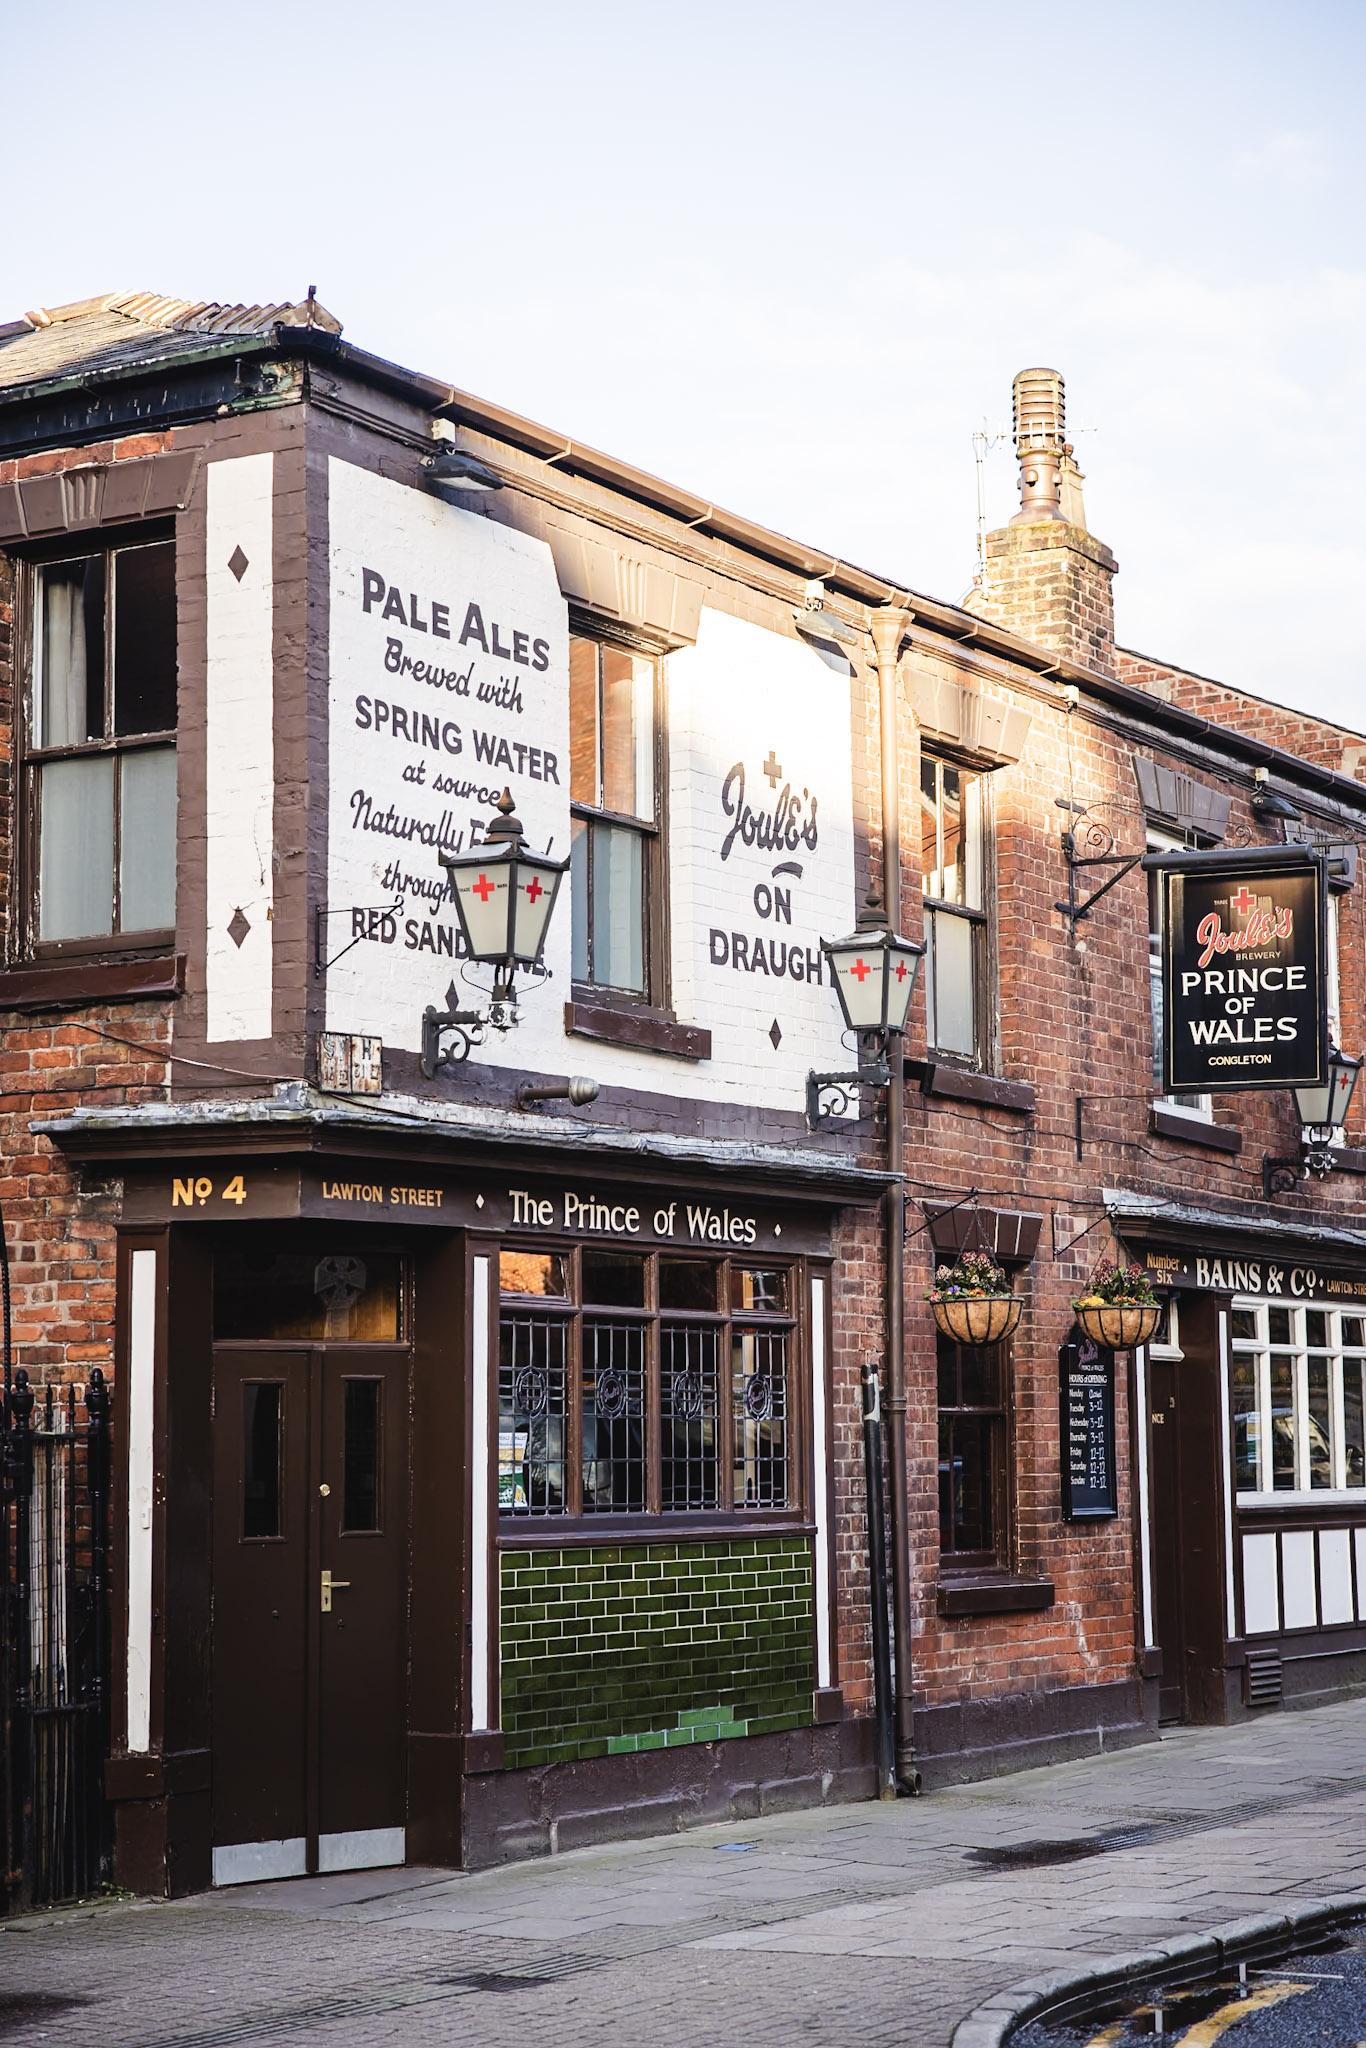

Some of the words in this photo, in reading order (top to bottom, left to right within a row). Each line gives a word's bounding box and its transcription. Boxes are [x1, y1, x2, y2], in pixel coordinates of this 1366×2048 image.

[362, 566, 450, 640] PALE
[458, 602, 550, 672] ALES
[384, 636, 475, 697] Brewed
[476, 675, 524, 714] with
[355, 694, 463, 755] SPRING
[472, 729, 560, 785] WATER
[402, 760, 426, 785] at
[432, 773, 500, 807] source
[350, 789, 464, 854] Naturally
[720, 761, 818, 861] Joule's
[380, 860, 455, 916] through
[753, 883, 792, 925] ON
[351, 906, 397, 945] RED
[1196, 905, 1294, 969] Joule's
[1235, 950, 1281, 961] BREWERY
[1181, 965, 1307, 997] PRINCE
[1225, 996, 1256, 1015] OF
[1188, 1016, 1298, 1046] WALES
[1208, 1054, 1272, 1067] CONGLETON
[221, 1175, 247, 1205] 4
[322, 1181, 383, 1203] LAWTON
[390, 1187, 444, 1208] STREET
[508, 1189, 554, 1226] The
[563, 1192, 640, 1234] Prince
[653, 1202, 678, 1237] of
[686, 1205, 757, 1243] Wales
[1147, 1252, 1180, 1271] Number
[1156, 1269, 1174, 1285] Six
[1196, 1258, 1262, 1294] BAINS
[1267, 1264, 1284, 1294] &
[1327, 1279, 1352, 1295] LAWTON
[1069, 1374, 1084, 1383] HOURS
[1087, 1375, 1107, 1384] OPENING
[1069, 1388, 1084, 1399] Monday
[1089, 1388, 1102, 1399] Closed
[1069, 1402, 1085, 1414] Tuesday
[1089, 1399, 1104, 1412] 3-12
[1069, 1417, 1089, 1429] Wednesday
[1090, 1415, 1104, 1429] 3-12
[1069, 1432, 1087, 1443] Thursday
[1090, 1431, 1105, 1443] 3-12
[1069, 1446, 1082, 1457] Friday
[1070, 1461, 1087, 1472] Saturday
[1070, 1475, 1085, 1485] Sunday
